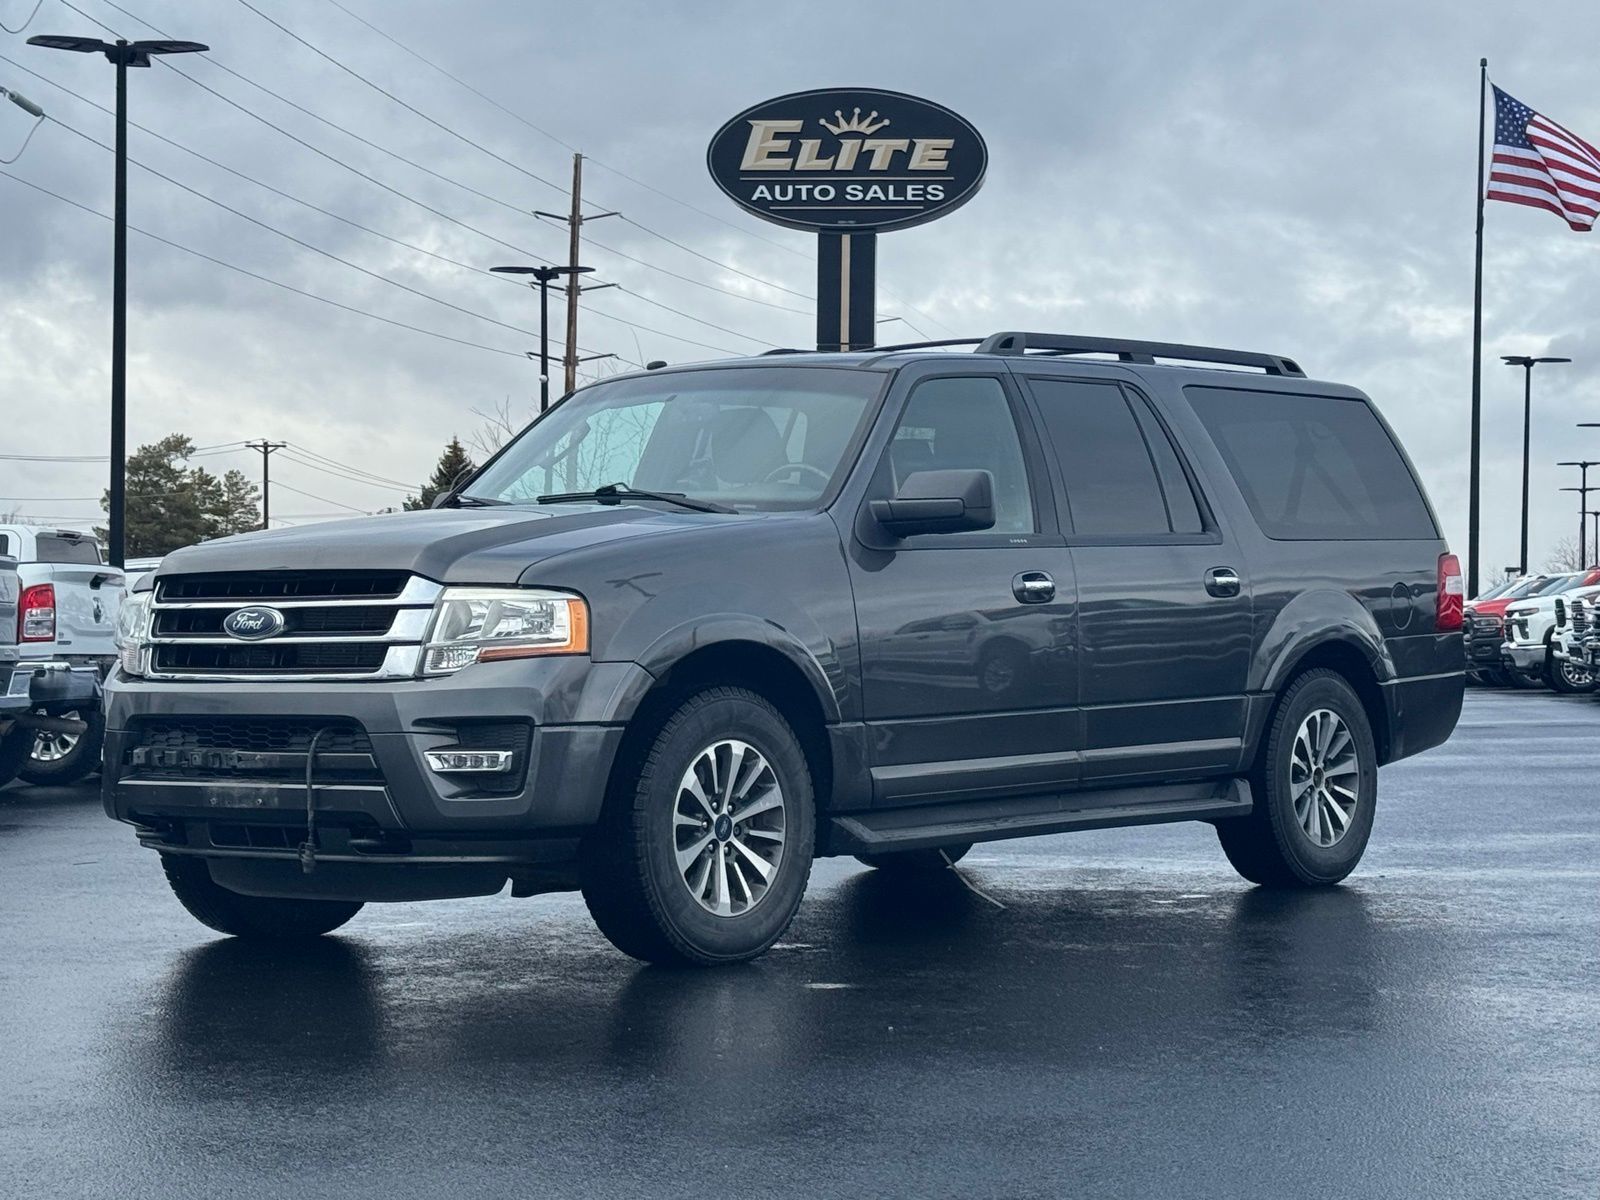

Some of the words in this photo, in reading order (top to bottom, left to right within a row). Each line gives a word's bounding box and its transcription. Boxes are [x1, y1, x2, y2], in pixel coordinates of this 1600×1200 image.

[739, 119, 955, 171] ELITE
[751, 184, 836, 201] AUTO
[845, 184, 945, 201] SALES
[232, 612, 265, 630] Ford
